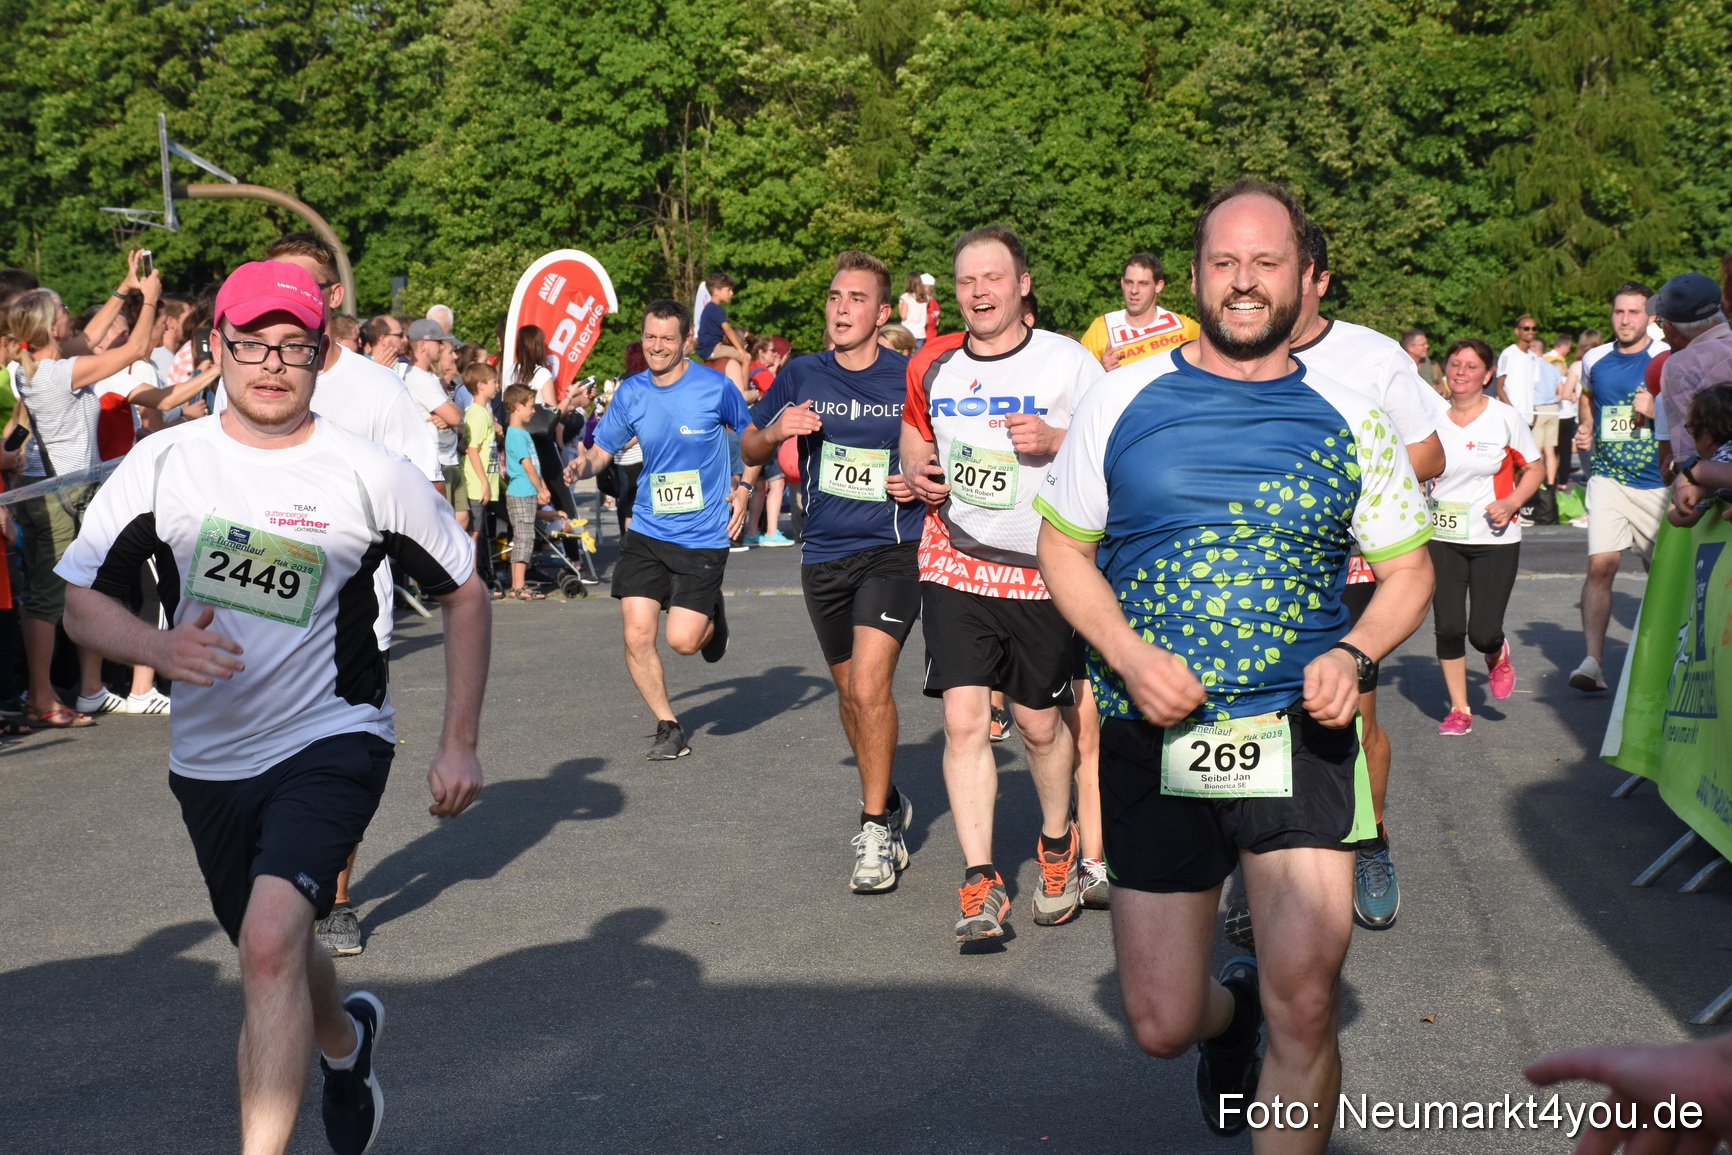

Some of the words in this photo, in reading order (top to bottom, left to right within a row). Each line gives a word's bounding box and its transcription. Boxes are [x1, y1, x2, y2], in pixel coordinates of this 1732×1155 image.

[538, 272, 559, 301] AVIA
[1149, 333, 1188, 351] BÖGL
[833, 463, 872, 486] 704
[954, 462, 1007, 492] 2075
[656, 485, 695, 502] 1074
[293, 504, 317, 512] TEAM
[278, 518, 330, 529] partner
[204, 550, 301, 600] 2449
[290, 563, 314, 575] 2019
[974, 564, 1026, 585] AVIA
[1260, 729, 1283, 740] 2019
[1188, 740, 1261, 772] 269
[1200, 774, 1231, 783] Seibel
[1233, 773, 1251, 782] Jan
